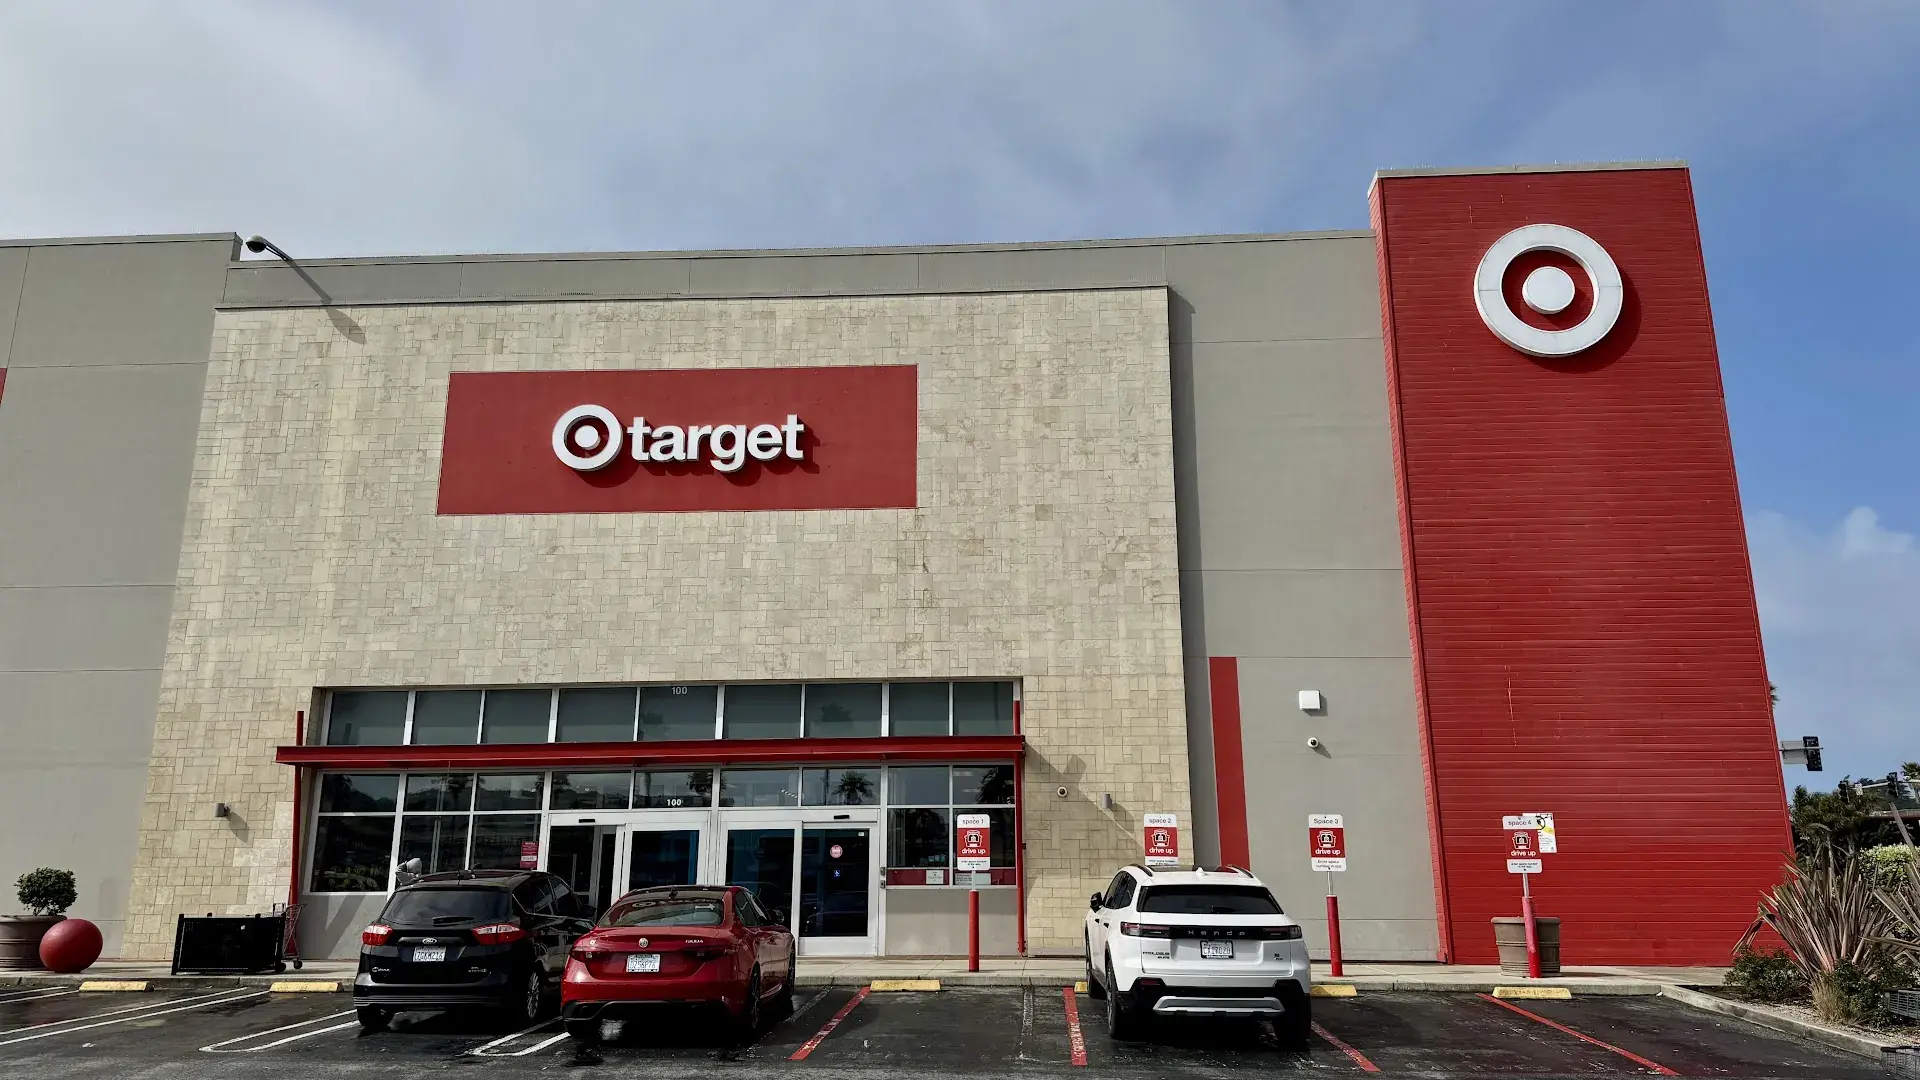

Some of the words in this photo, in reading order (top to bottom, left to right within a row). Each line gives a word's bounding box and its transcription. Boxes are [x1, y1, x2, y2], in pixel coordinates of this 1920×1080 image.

[627, 413, 804, 473] target
[671, 686, 688, 695] 100
[666, 798, 682, 806] 100
[1314, 847, 1331, 855] drive
[1331, 848, 1341, 856] up
